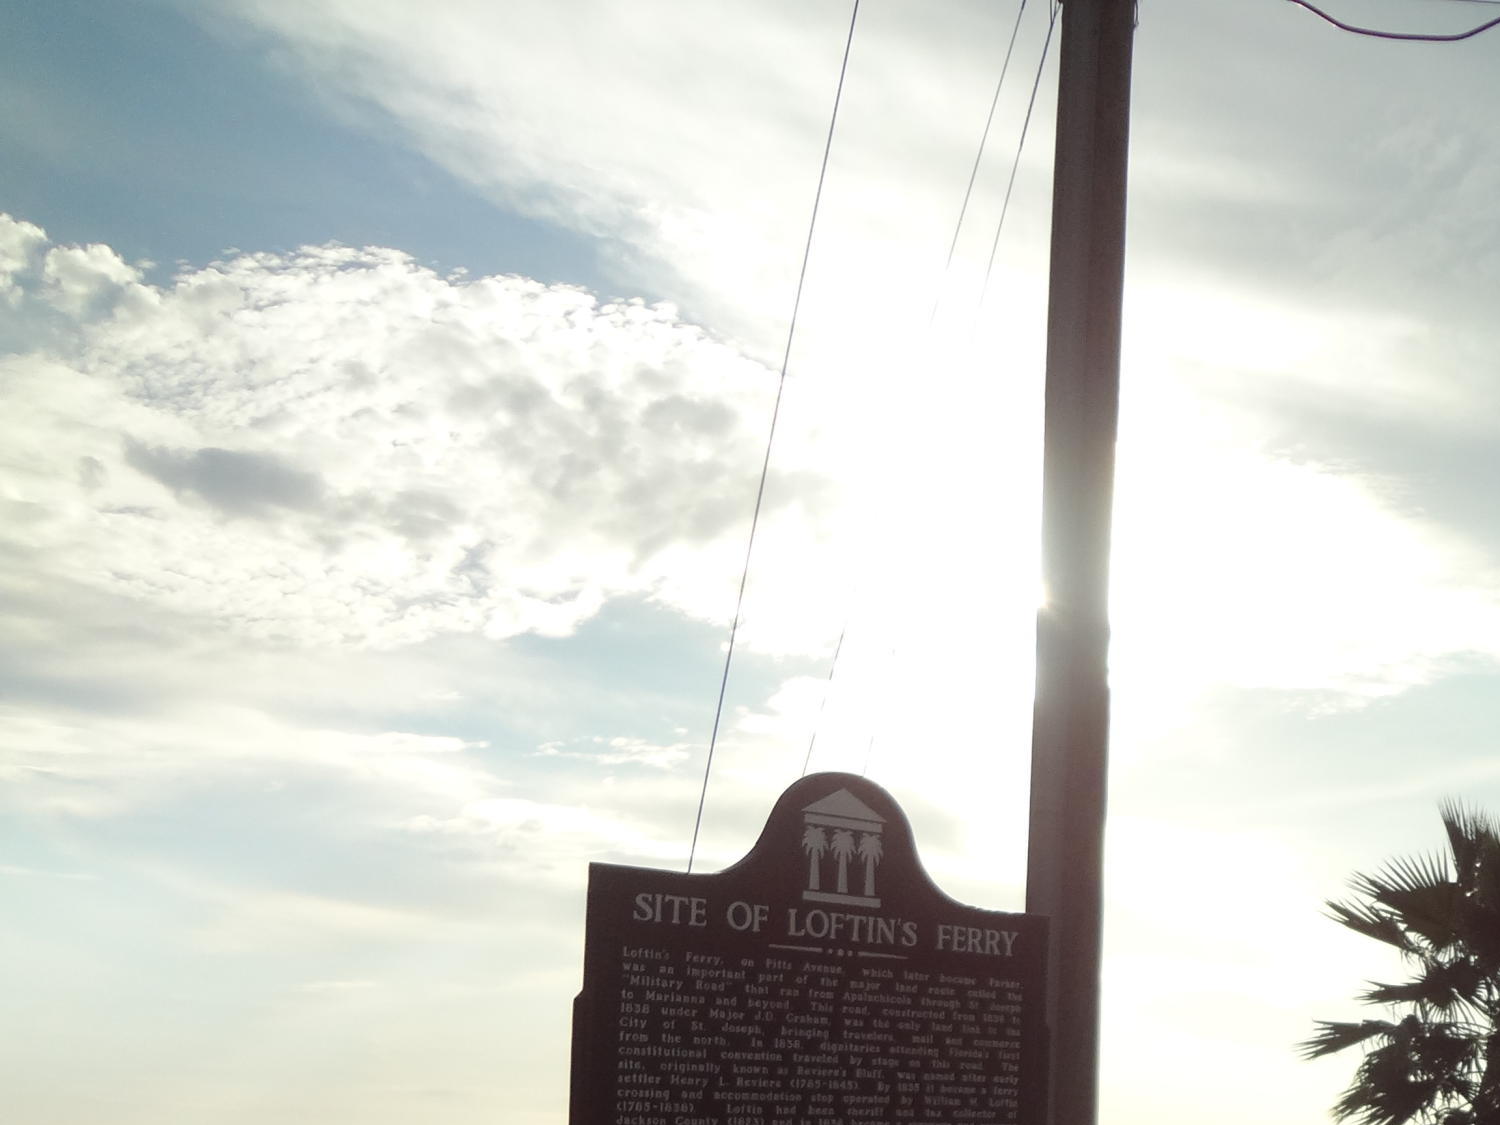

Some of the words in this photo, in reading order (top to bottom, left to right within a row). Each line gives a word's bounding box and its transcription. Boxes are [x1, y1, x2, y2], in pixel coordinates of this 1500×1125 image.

[633, 893, 707, 927] SITE
[727, 901, 770, 932] OF
[787, 908, 918, 947] LOFTIN'S
[937, 923, 1019, 957] FERRY
[622, 945, 670, 961] Loftin's
[685, 951, 724, 966] Ferry,
[740, 957, 754, 967] on
[765, 957, 792, 970] Pitts
[621, 961, 645, 976] was
[659, 965, 674, 974] an
[686, 966, 745, 982] important
[758, 971, 783, 985] part
[794, 974, 808, 984] of
[621, 974, 683, 990] "Military
[695, 979, 732, 992] Road"
[744, 983, 768, 995] that
[779, 987, 799, 997] ran
[620, 988, 634, 999] to
[645, 990, 705, 1004] Marianna
[715, 995, 737, 1006] and
[660, 1005, 698, 1017] under
[708, 1007, 745, 1021] Major
[618, 1016, 647, 1029] City
[662, 1018, 675, 1029] of
[780, 1025, 829, 1039] bringing
[618, 1030, 648, 1042] from
[661, 1032, 681, 1044] the
[693, 1034, 730, 1046] north.
[751, 1037, 763, 1047] In
[617, 1044, 707, 1058] constitutional
[720, 1049, 782, 1061] convention
[792, 1052, 838, 1063] traveled
[617, 1058, 645, 1070] site,
[659, 1060, 720, 1074] originally
[732, 1063, 768, 1074] known
[776, 1067, 788, 1075] as
[617, 1072, 661, 1084] settler
[669, 1074, 708, 1088] Henry
[718, 1076, 728, 1086] L.
[736, 1076, 781, 1088] Reviere
[616, 1088, 670, 1101] crossing
[680, 1089, 703, 1099] and
[713, 1089, 802, 1102] accommodation
[726, 1103, 762, 1114] Loftin
[775, 1104, 796, 1115] had
[615, 1114, 666, 1125] Jackson
